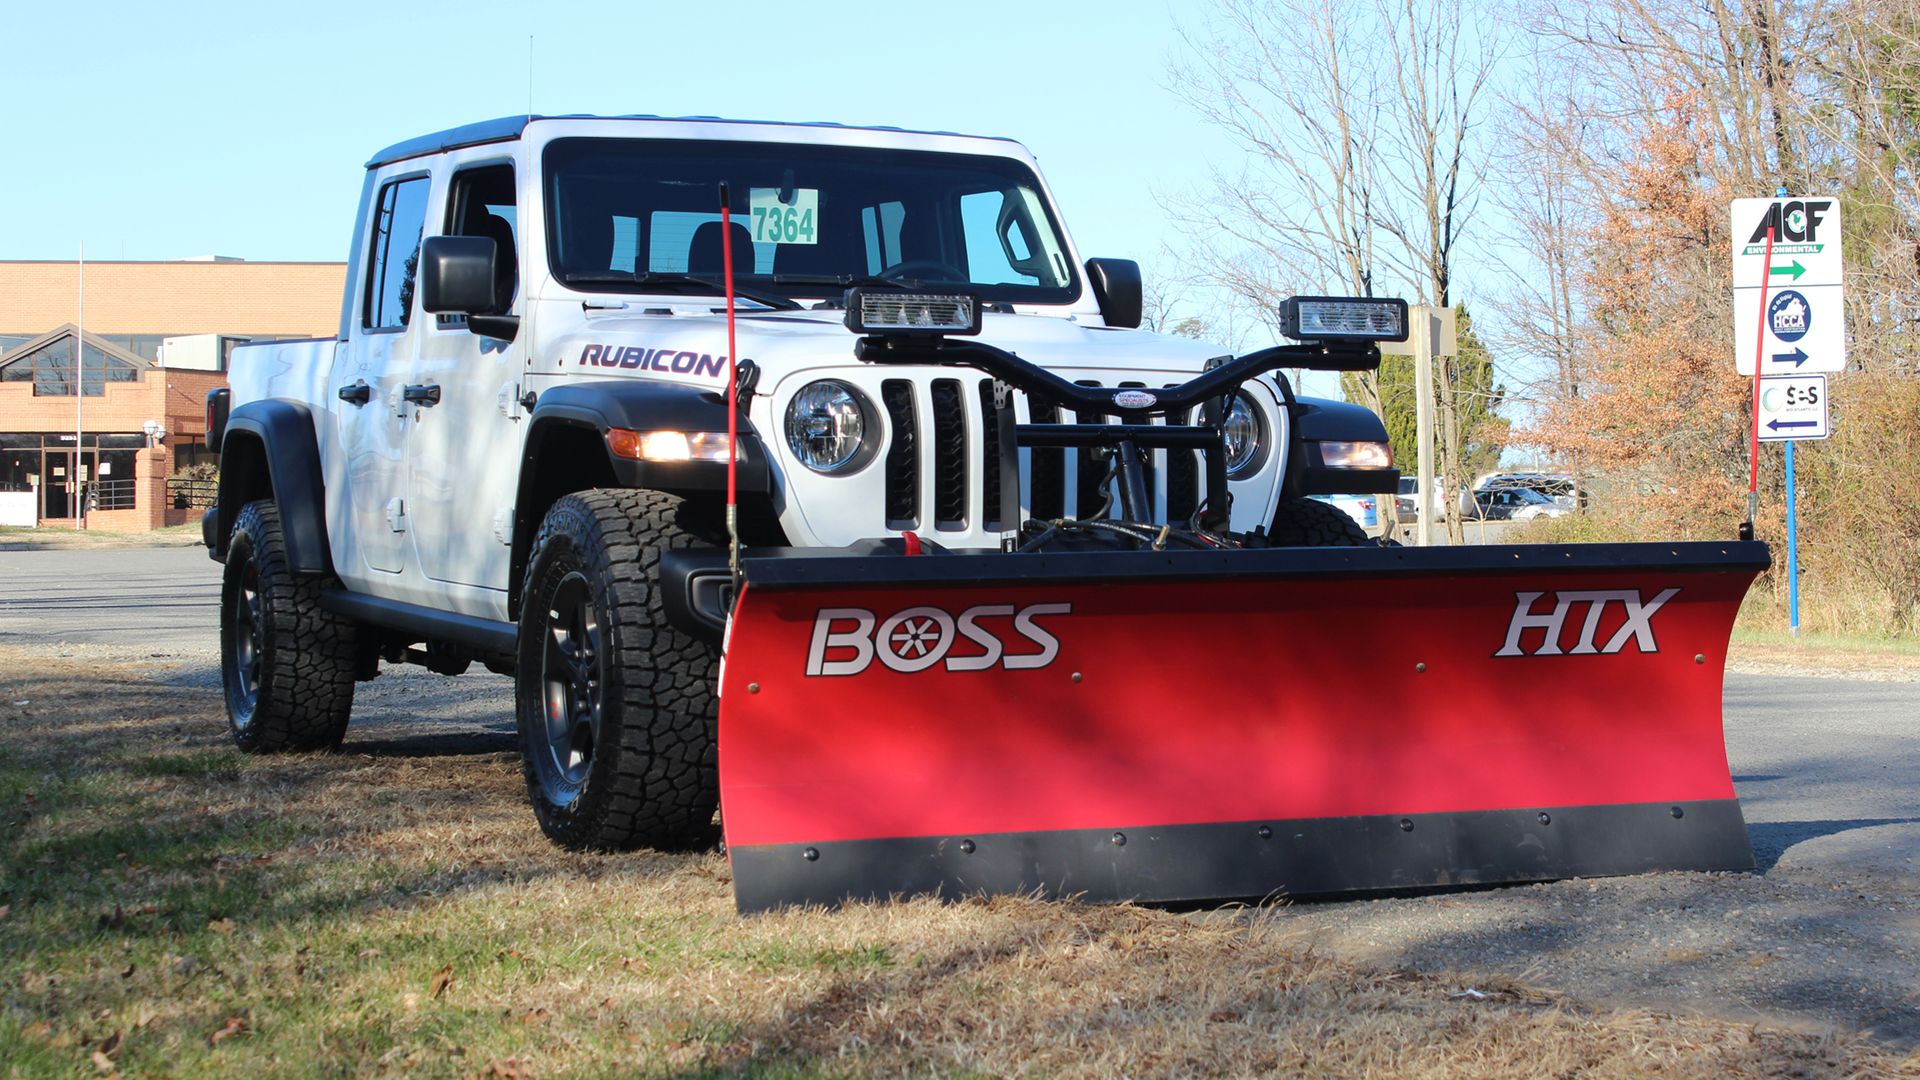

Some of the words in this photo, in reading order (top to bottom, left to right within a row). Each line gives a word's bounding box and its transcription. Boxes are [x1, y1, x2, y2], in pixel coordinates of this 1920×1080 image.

[753, 207, 814, 242] 7364
[1748, 201, 1832, 243] ACF
[1746, 245, 1819, 254] ENVIONMENTAL
[1774, 315, 1806, 328] HCCA
[579, 344, 728, 377] RUBICON
[805, 603, 1072, 676] BOSS
[1493, 587, 1682, 657] HTX
